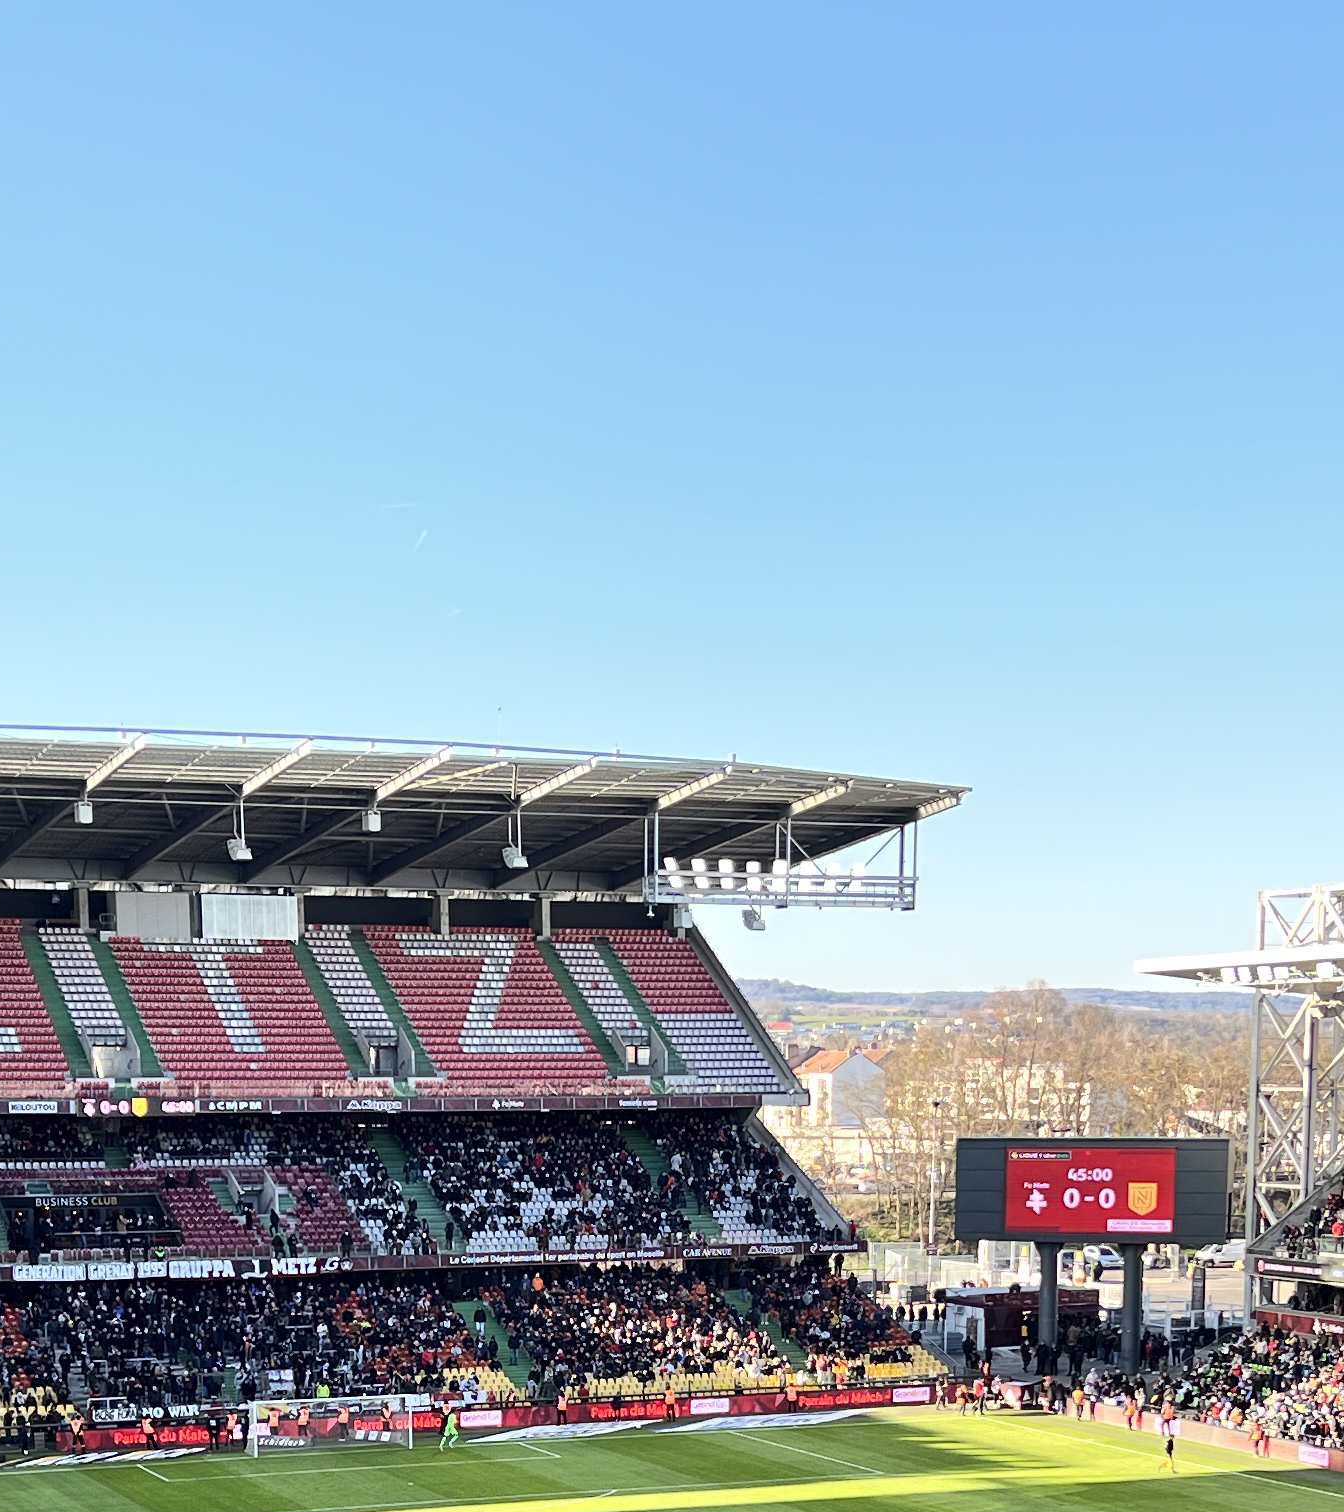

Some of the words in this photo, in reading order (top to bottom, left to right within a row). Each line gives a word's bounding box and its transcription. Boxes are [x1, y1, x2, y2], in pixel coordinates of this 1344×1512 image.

[1067, 1168, 1113, 1182] 45:00
[35, 1198, 89, 1207] BUSINESS
[90, 1196, 118, 1206] CLUB
[13, 1264, 86, 1281] GENERATION
[88, 1262, 134, 1279] GRENAT
[168, 1259, 235, 1279] GRUPPA
[271, 1257, 317, 1275] METZ
[836, 1393, 849, 1405] du
[851, 1391, 883, 1404] Match
